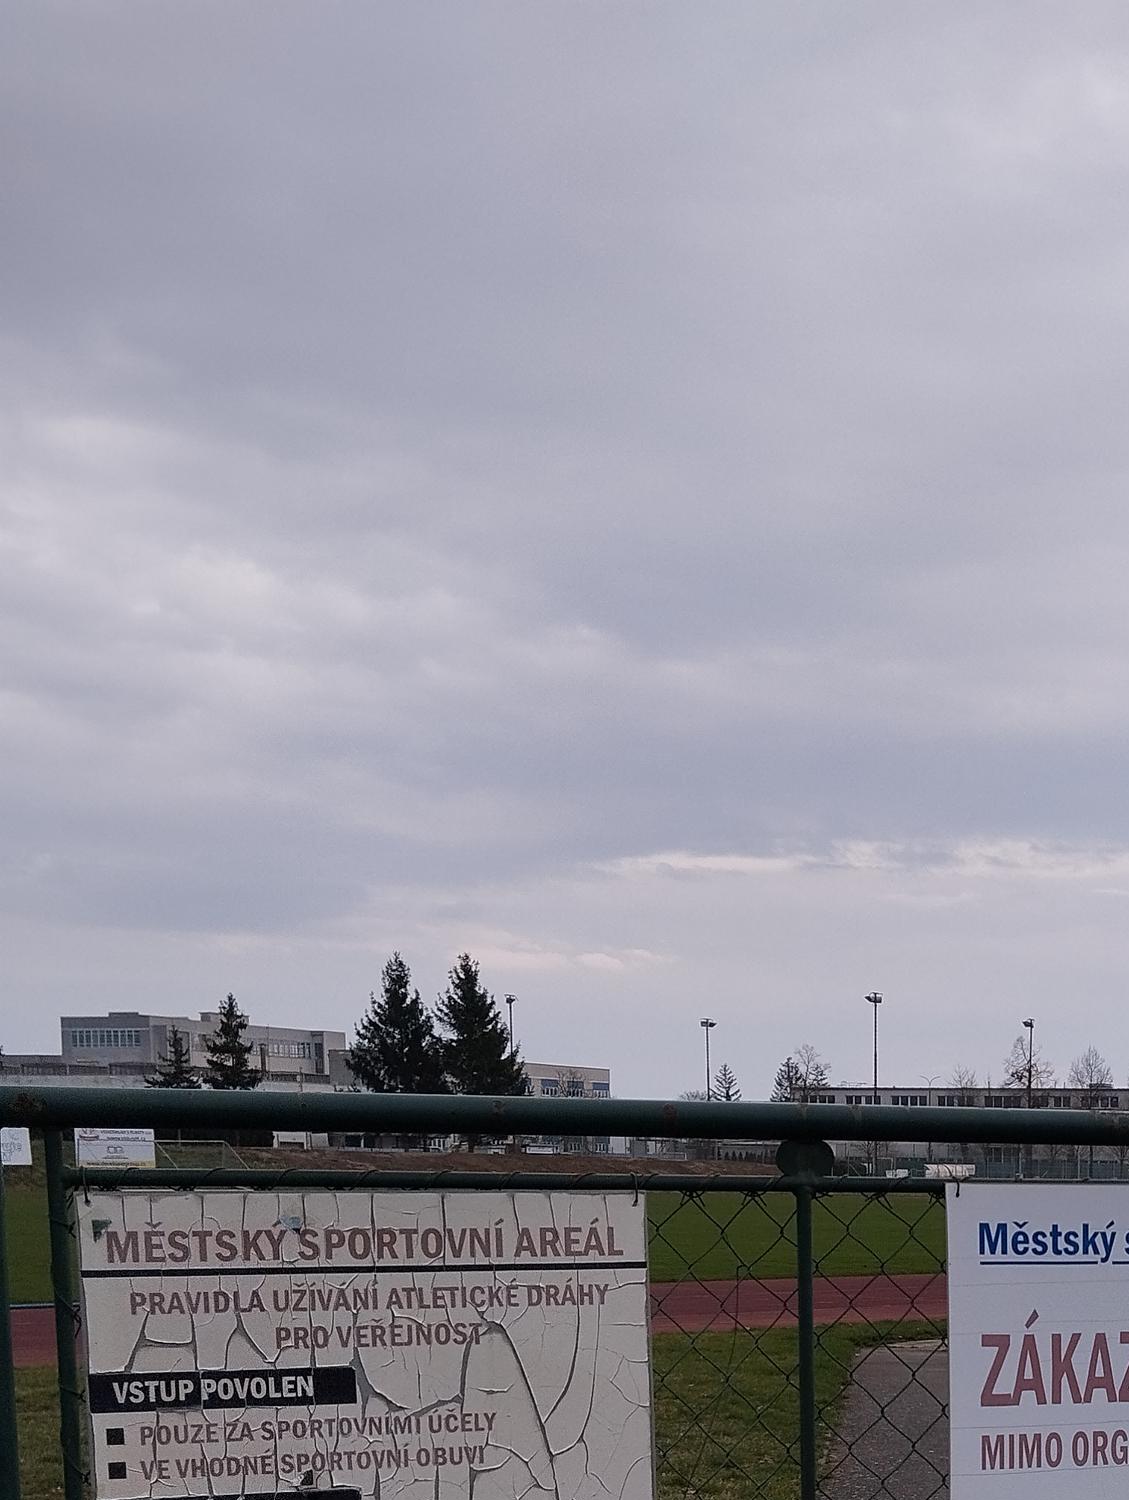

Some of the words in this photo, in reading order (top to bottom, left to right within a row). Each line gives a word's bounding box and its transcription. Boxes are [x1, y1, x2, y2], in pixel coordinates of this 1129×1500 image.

[106, 1220, 286, 1264] MĚSTSKÝ
[298, 1218, 504, 1261] SPORTOVNÍ
[514, 1217, 624, 1257] AREÁL
[978, 1220, 1115, 1262] Městský
[130, 1290, 266, 1316] PRAVIDLA
[273, 1279, 378, 1312] UŽÍVÁNÍ
[386, 1278, 520, 1310] ATLETICKÉ
[527, 1277, 609, 1307] DRÁHY
[275, 1326, 329, 1350] PRO
[336, 1318, 483, 1348] VEŘEJNOST
[113, 1379, 194, 1404] VSTUP
[200, 1376, 314, 1401] POVOLEN
[140, 1423, 218, 1446] POUZE
[226, 1421, 254, 1442] ZA
[261, 1410, 421, 1441] SPORTOVNÍMI
[428, 1408, 496, 1434] ÚČELY
[140, 1460, 170, 1480] VE
[176, 1449, 274, 1478] VHODNÉ
[280, 1443, 408, 1473] SPORTOVNÍ
[416, 1445, 485, 1467] OBUVI
[980, 1431, 1062, 1471] MIMO
